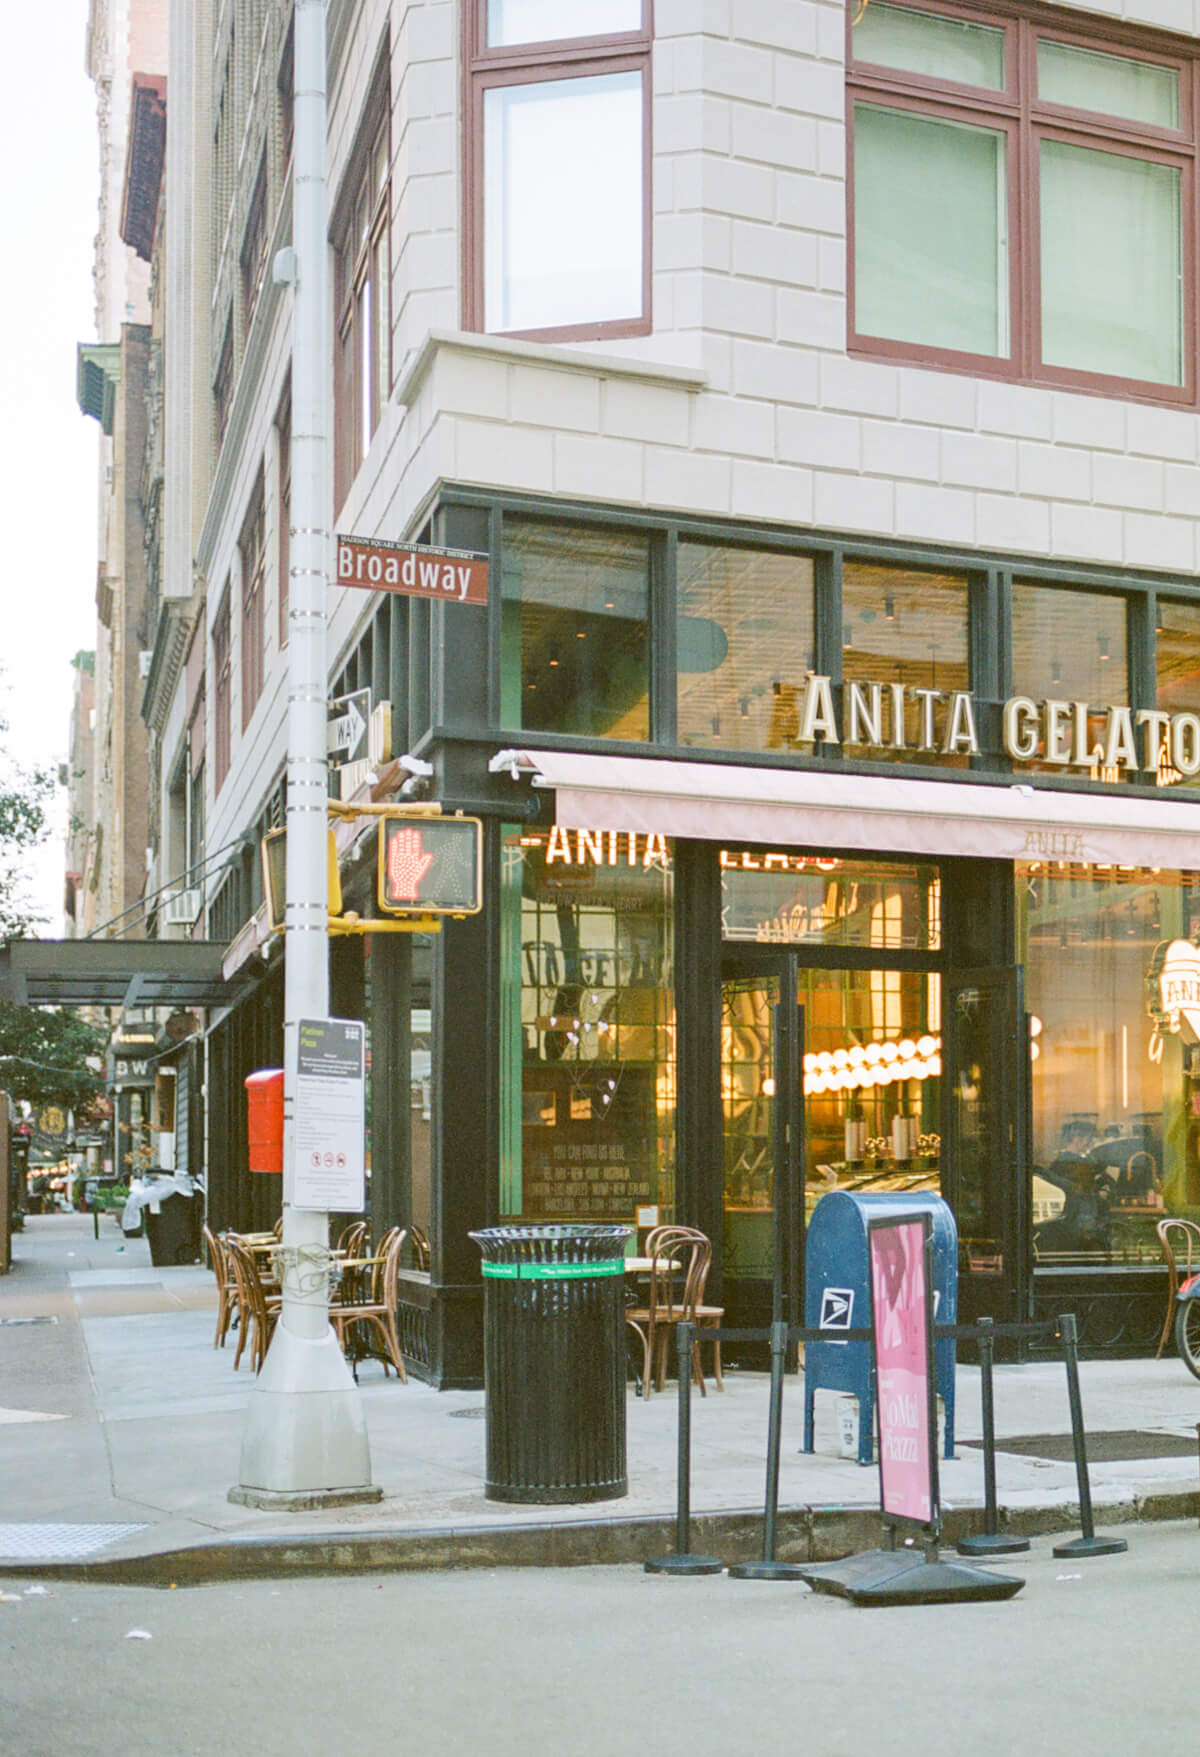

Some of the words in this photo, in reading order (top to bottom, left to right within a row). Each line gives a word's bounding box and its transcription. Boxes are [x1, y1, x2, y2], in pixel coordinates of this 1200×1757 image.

[371, 539, 394, 549] SQUARE
[339, 546, 472, 601] Broadway
[336, 717, 358, 747] WAY
[797, 674, 983, 757] ANITA
[545, 824, 670, 867] ANITA
[1024, 828, 1087, 858] ANITA
